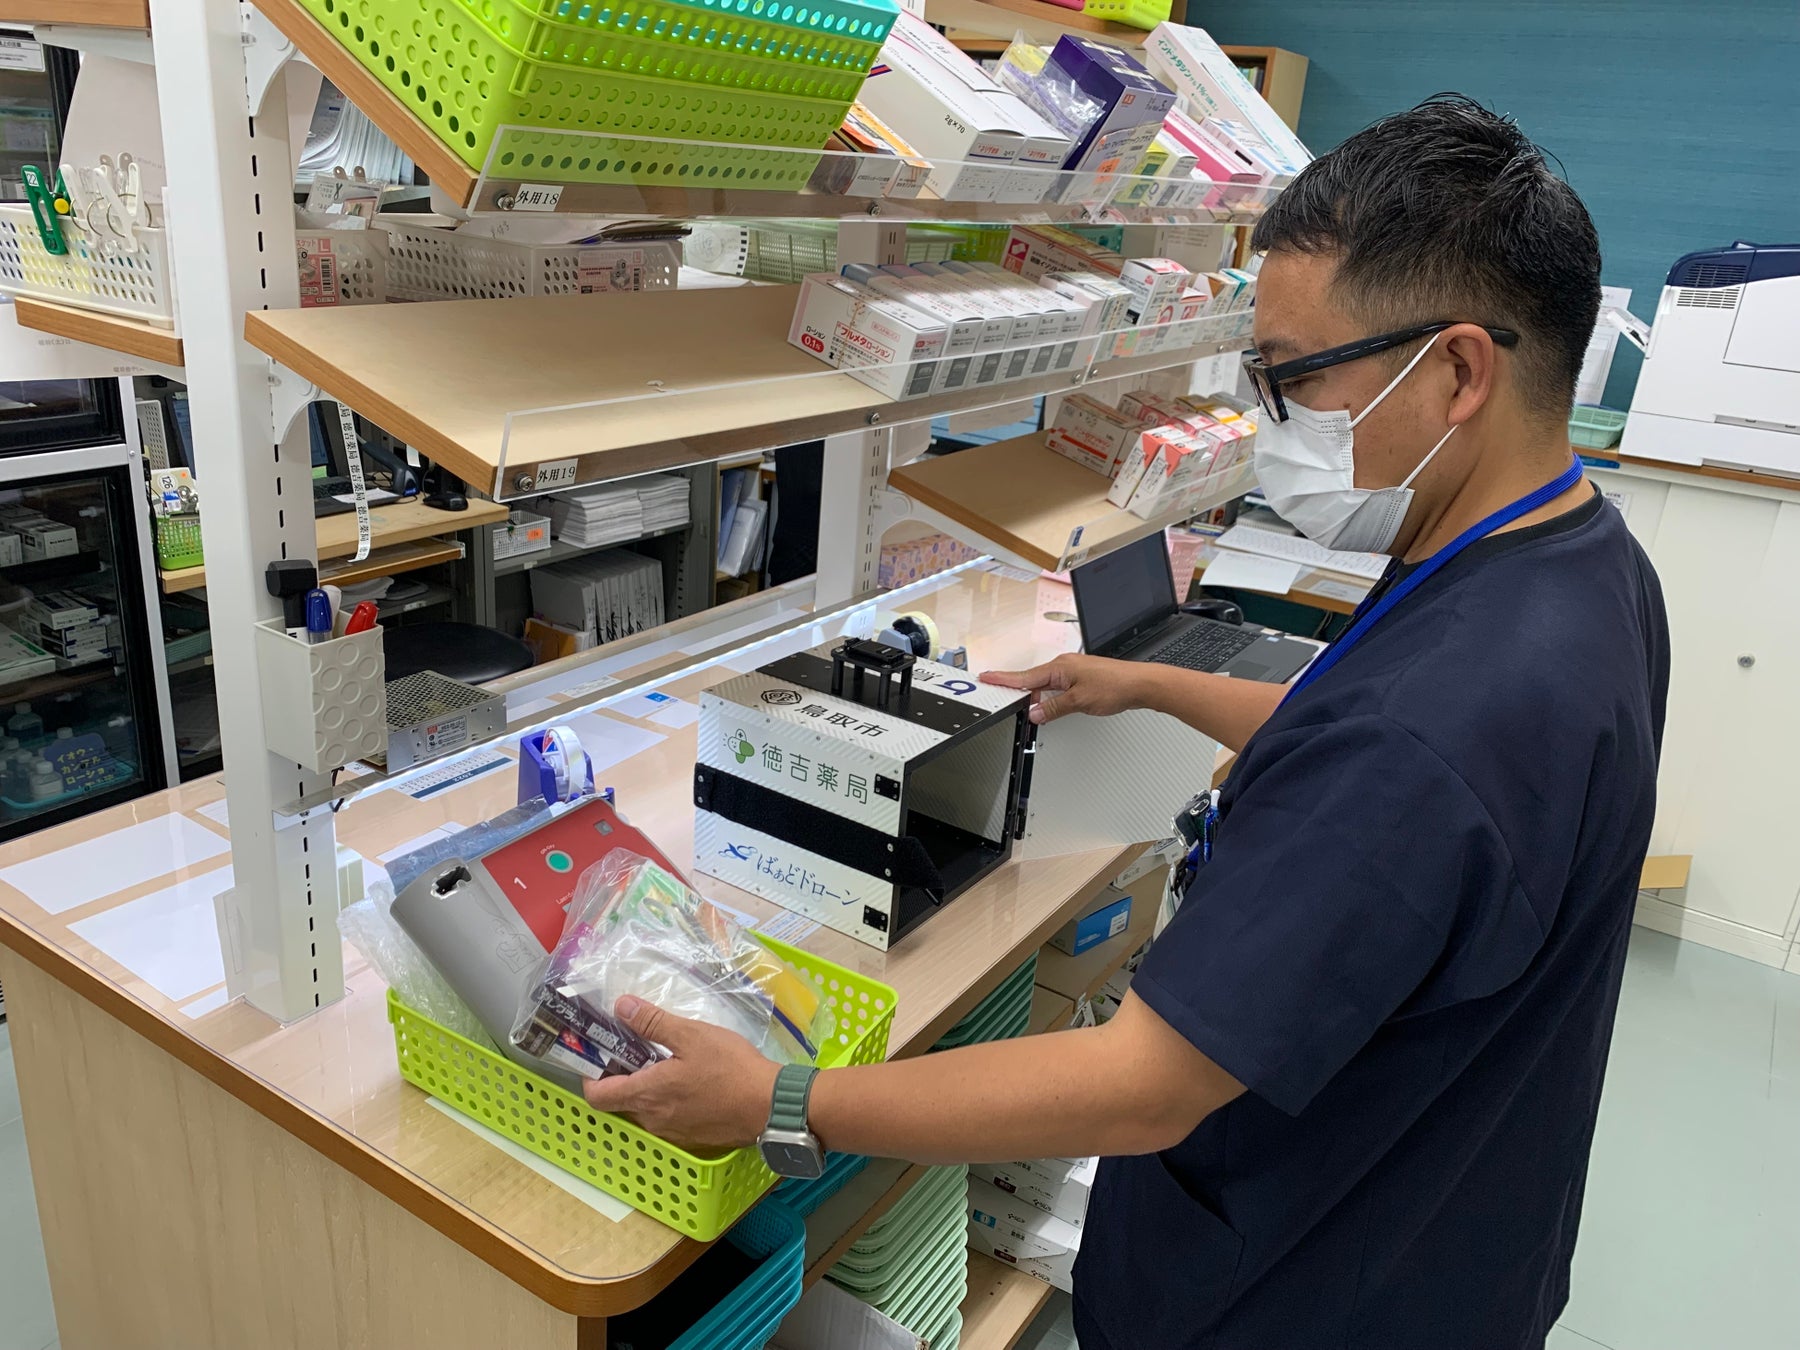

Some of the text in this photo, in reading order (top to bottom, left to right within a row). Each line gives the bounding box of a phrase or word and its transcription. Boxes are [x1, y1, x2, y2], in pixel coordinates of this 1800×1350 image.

[515, 190, 560, 206] 外用18
[805, 325, 826, 340] ローション
[161, 475, 174, 489] 126
[536, 466, 576, 483] 外用19
[794, 703, 890, 738] 鳥取市
[761, 742, 869, 805] 徳吉薬局
[513, 876, 527, 890] 1
[756, 853, 862, 906] ばぁどドローン
